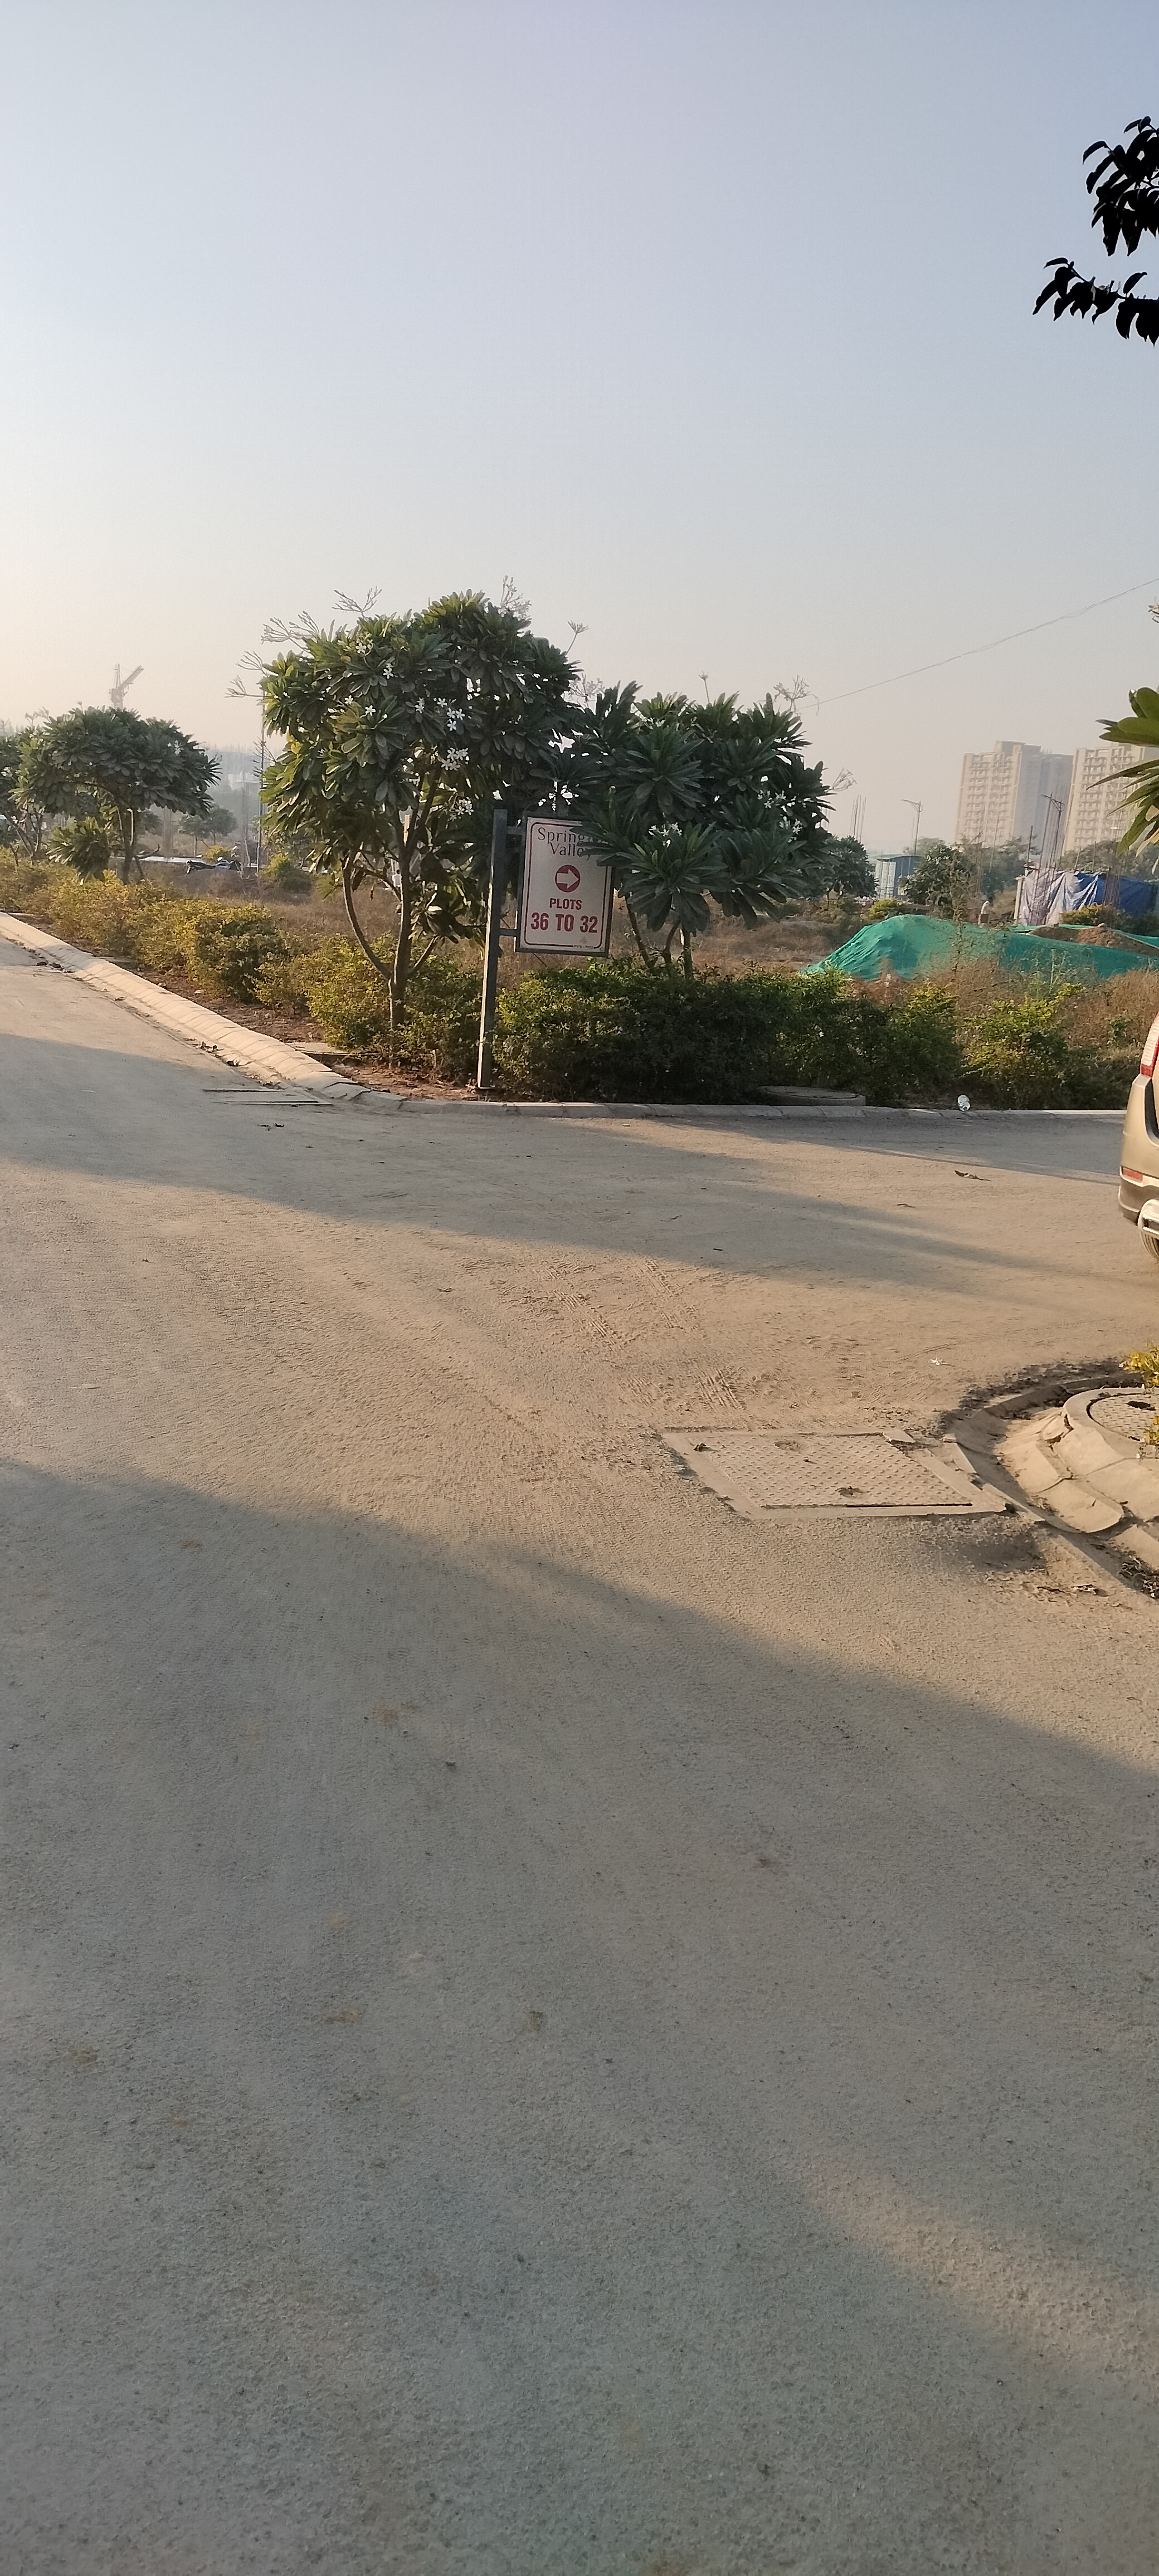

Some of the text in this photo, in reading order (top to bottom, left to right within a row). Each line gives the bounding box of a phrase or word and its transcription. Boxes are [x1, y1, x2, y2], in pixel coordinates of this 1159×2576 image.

[549, 897, 582, 910] PLOTS
[530, 912, 598, 933] 36 TO 32
